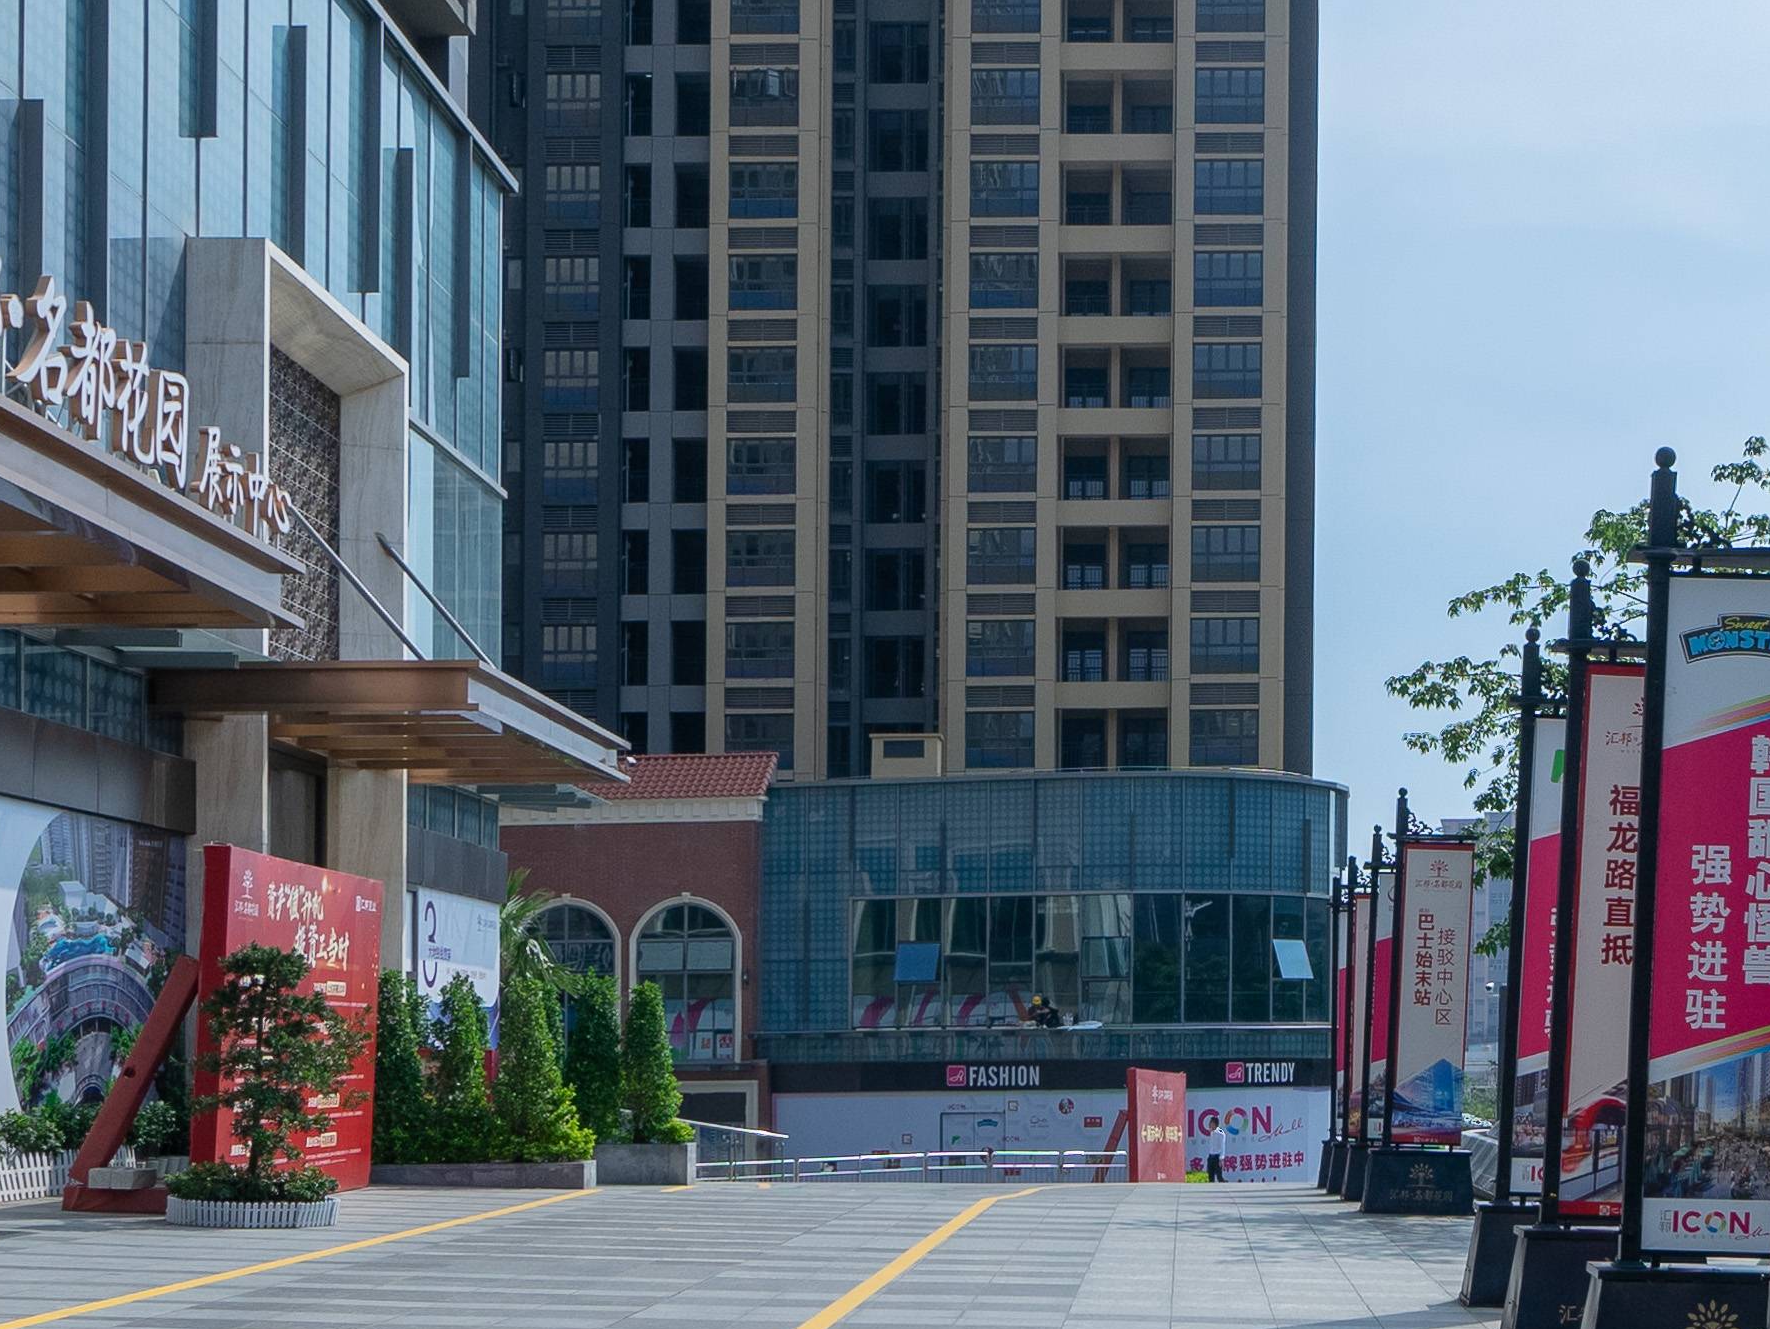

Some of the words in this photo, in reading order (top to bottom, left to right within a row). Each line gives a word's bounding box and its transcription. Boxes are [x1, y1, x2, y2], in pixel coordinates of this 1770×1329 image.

[195, 426, 291, 534] 展示中心
[1601, 783, 1640, 967] 福龙路直抵
[1413, 913, 1435, 1007] 巴士始末站
[1684, 843, 1733, 1032] 强势进驻
[1434, 927, 1456, 1026] 接驳中心区
[969, 1065, 1040, 1087] FASHION
[1245, 1062, 1295, 1083] TRENDY
[1187, 1105, 1272, 1138] ICON
[1189, 1150, 1305, 1172] 多牌强势进驻中
[1672, 1209, 1751, 1235] ICON
